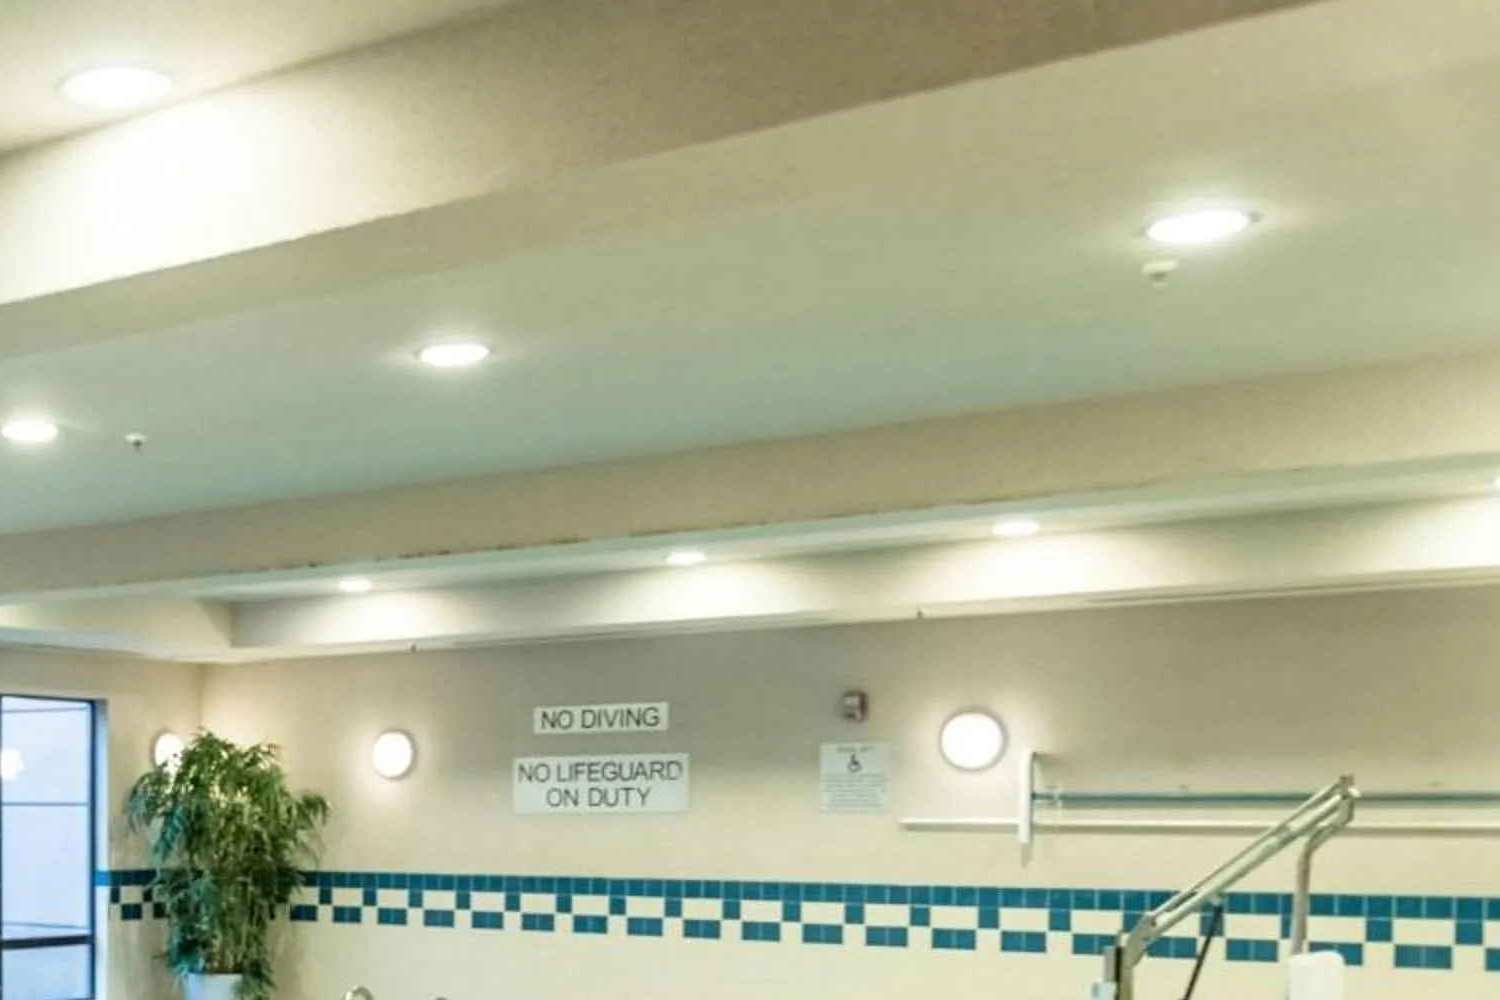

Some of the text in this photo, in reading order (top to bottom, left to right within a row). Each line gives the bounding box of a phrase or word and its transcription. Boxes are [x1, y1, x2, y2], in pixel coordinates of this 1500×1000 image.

[540, 706, 661, 730] NO DIVING
[518, 760, 683, 783] NO LIFEGUARD
[546, 786, 651, 808] ON DUTY
